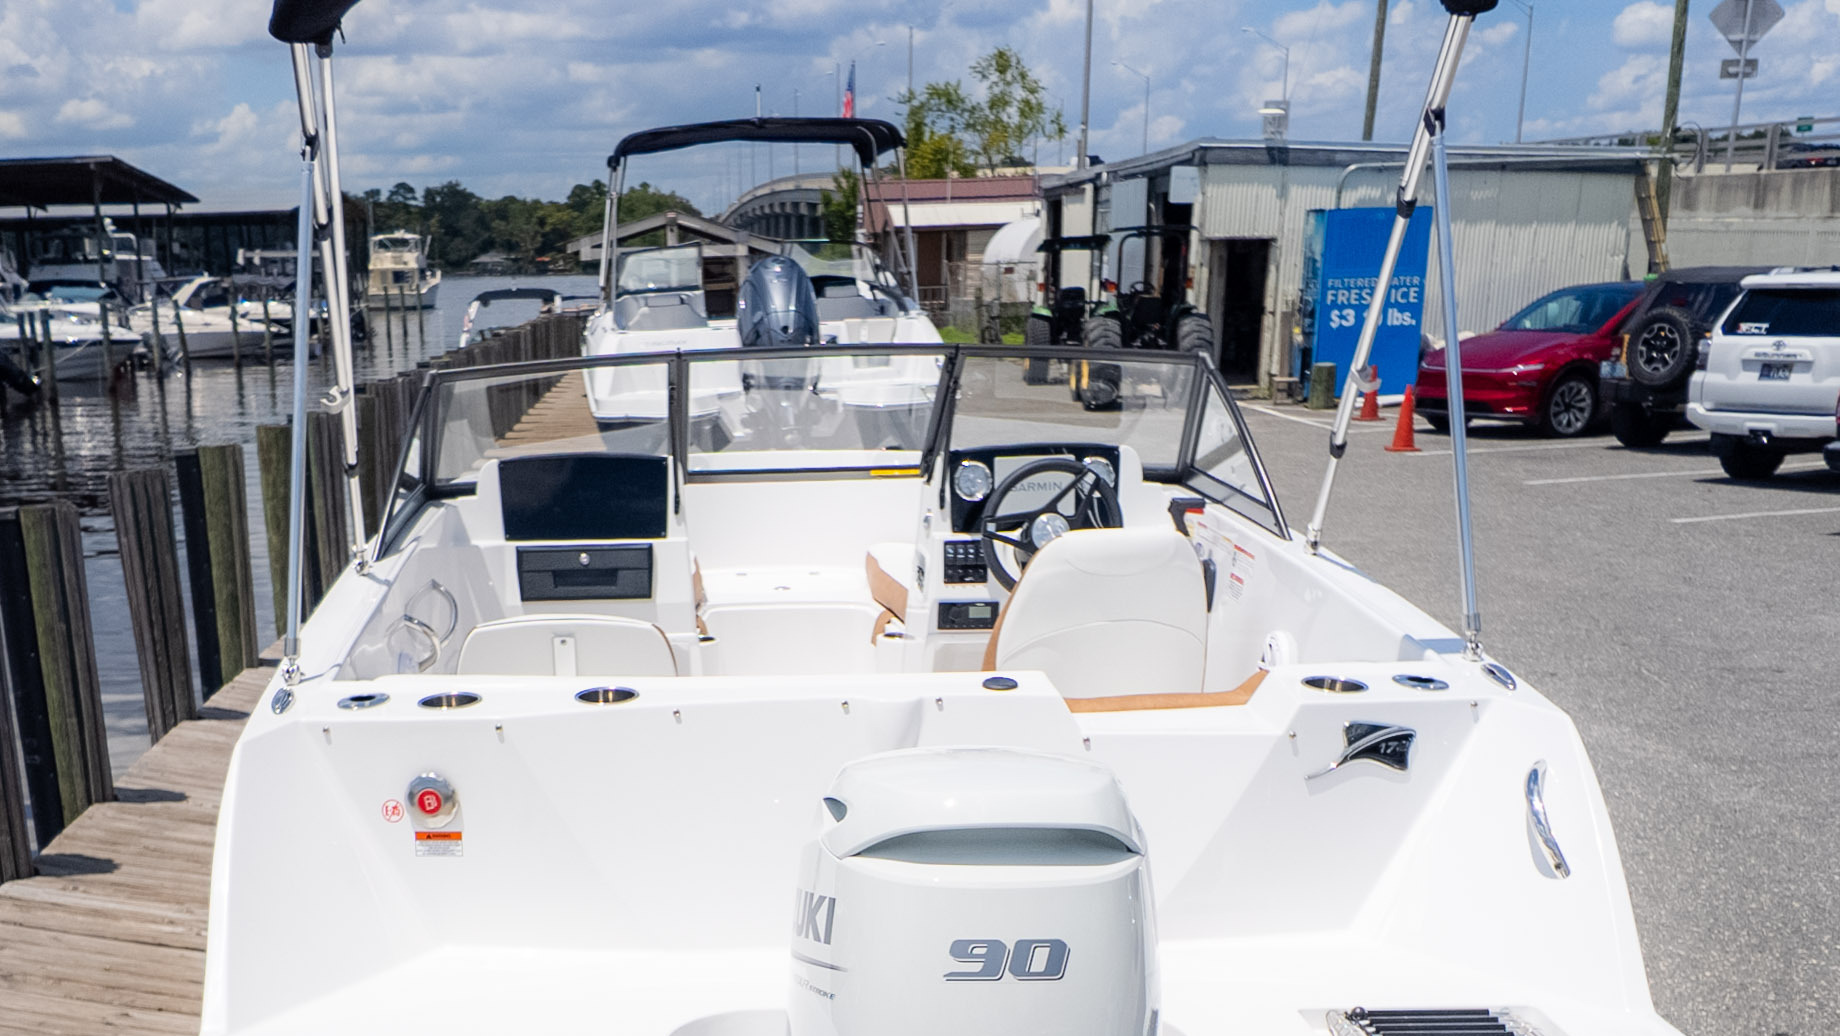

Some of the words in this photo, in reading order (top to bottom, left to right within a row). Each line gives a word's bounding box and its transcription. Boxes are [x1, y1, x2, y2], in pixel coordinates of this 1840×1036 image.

[1389, 276, 1421, 287] ATER
[1326, 288, 1373, 305] FRES
[1390, 287, 1420, 304] ICE
[1329, 308, 1356, 330] $3
[1386, 308, 1417, 327] lbs.
[943, 938, 1071, 982] 90
